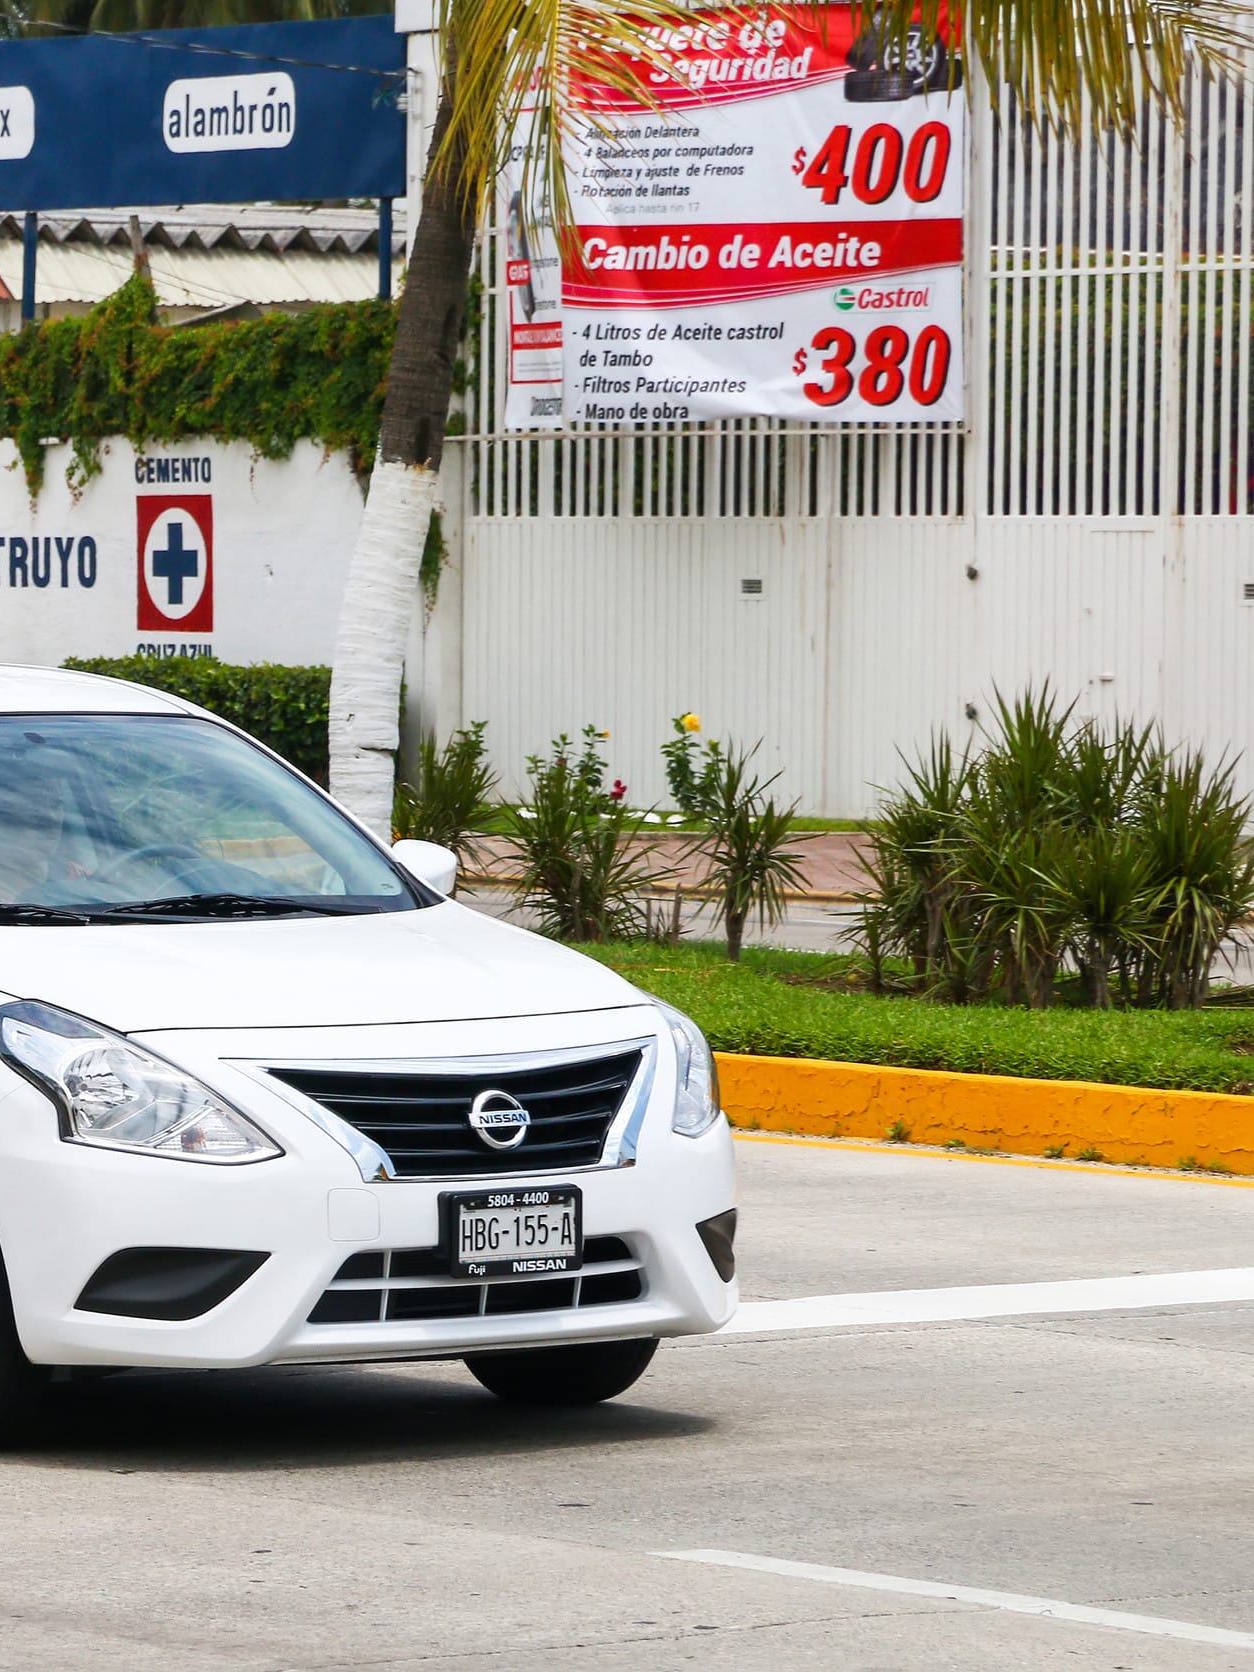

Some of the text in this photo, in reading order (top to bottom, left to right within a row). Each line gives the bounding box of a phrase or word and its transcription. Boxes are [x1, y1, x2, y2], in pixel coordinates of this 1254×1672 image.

[738, 10, 786, 50] de
[169, 87, 292, 139] alambrón
[644, 125, 700, 139] Delantera
[596, 146, 649, 159] Balanceos
[652, 148, 672, 160] por
[674, 143, 754, 160] computadora
[582, 163, 744, 181] Limpieza y ajuste de Frenos
[791, 120, 952, 206] $400
[581, 183, 690, 198] Rotación de llantas
[688, 201, 701, 213] 17
[582, 232, 881, 271] Cambio de Aceite
[856, 286, 930, 310] Castrol
[582, 323, 592, 341] 4
[595, 322, 642, 342] Litros
[647, 322, 667, 341] de
[671, 322, 723, 342] Aceite
[727, 321, 785, 341] castrol
[579, 350, 598, 368] de
[602, 349, 654, 369] Tambo
[791, 323, 952, 407] $380
[582, 376, 747, 398] Filtros Participantes
[585, 403, 689, 421] Mano de obra
[135, 456, 213, 485] CEMENTO
[479, 1112, 527, 1125] NISSAN
[461, 1212, 572, 1252] HBG-155-A
[512, 1258, 567, 1273] NISSAN
